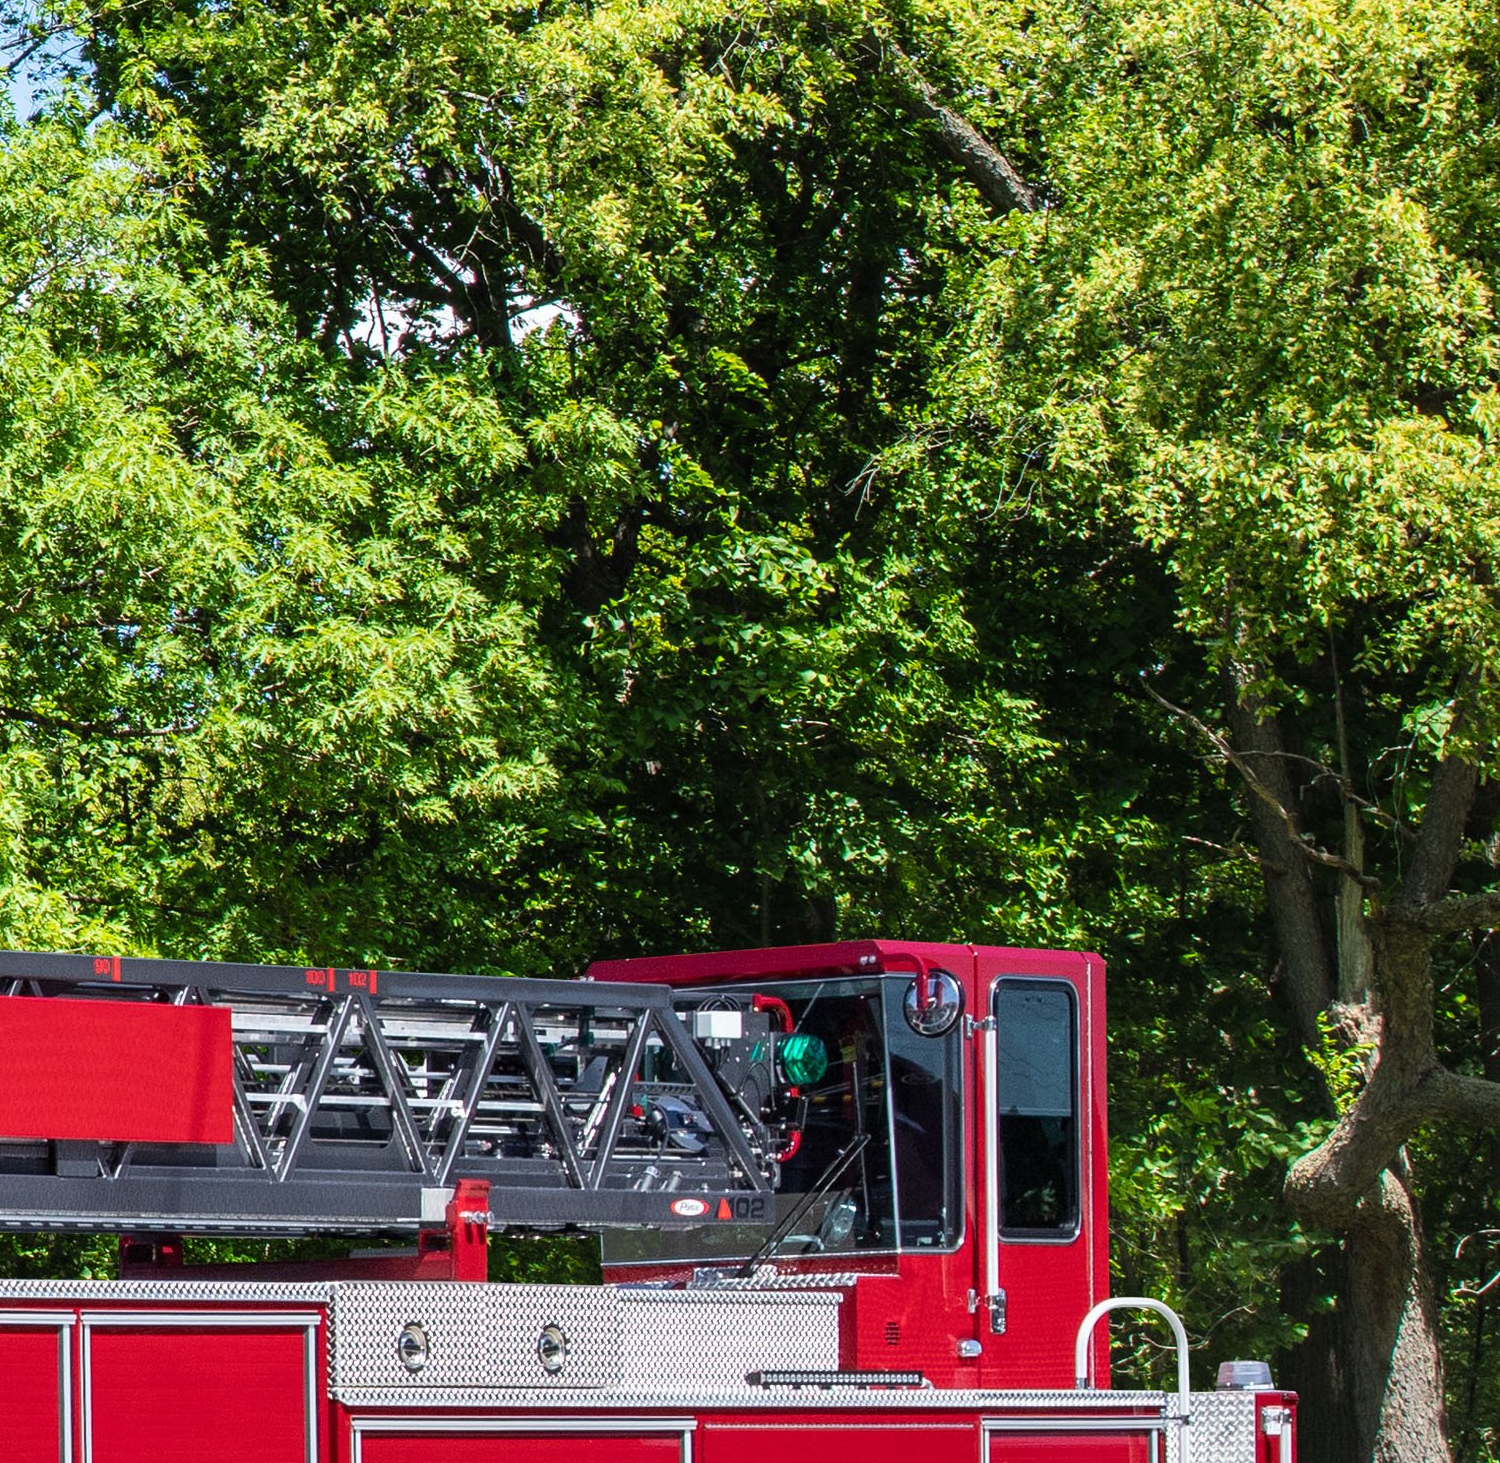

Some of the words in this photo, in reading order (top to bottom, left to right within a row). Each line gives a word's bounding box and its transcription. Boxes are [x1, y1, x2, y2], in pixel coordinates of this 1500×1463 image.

[93, 958, 110, 974] 90
[305, 969, 326, 986] 100
[348, 971, 367, 987] 102
